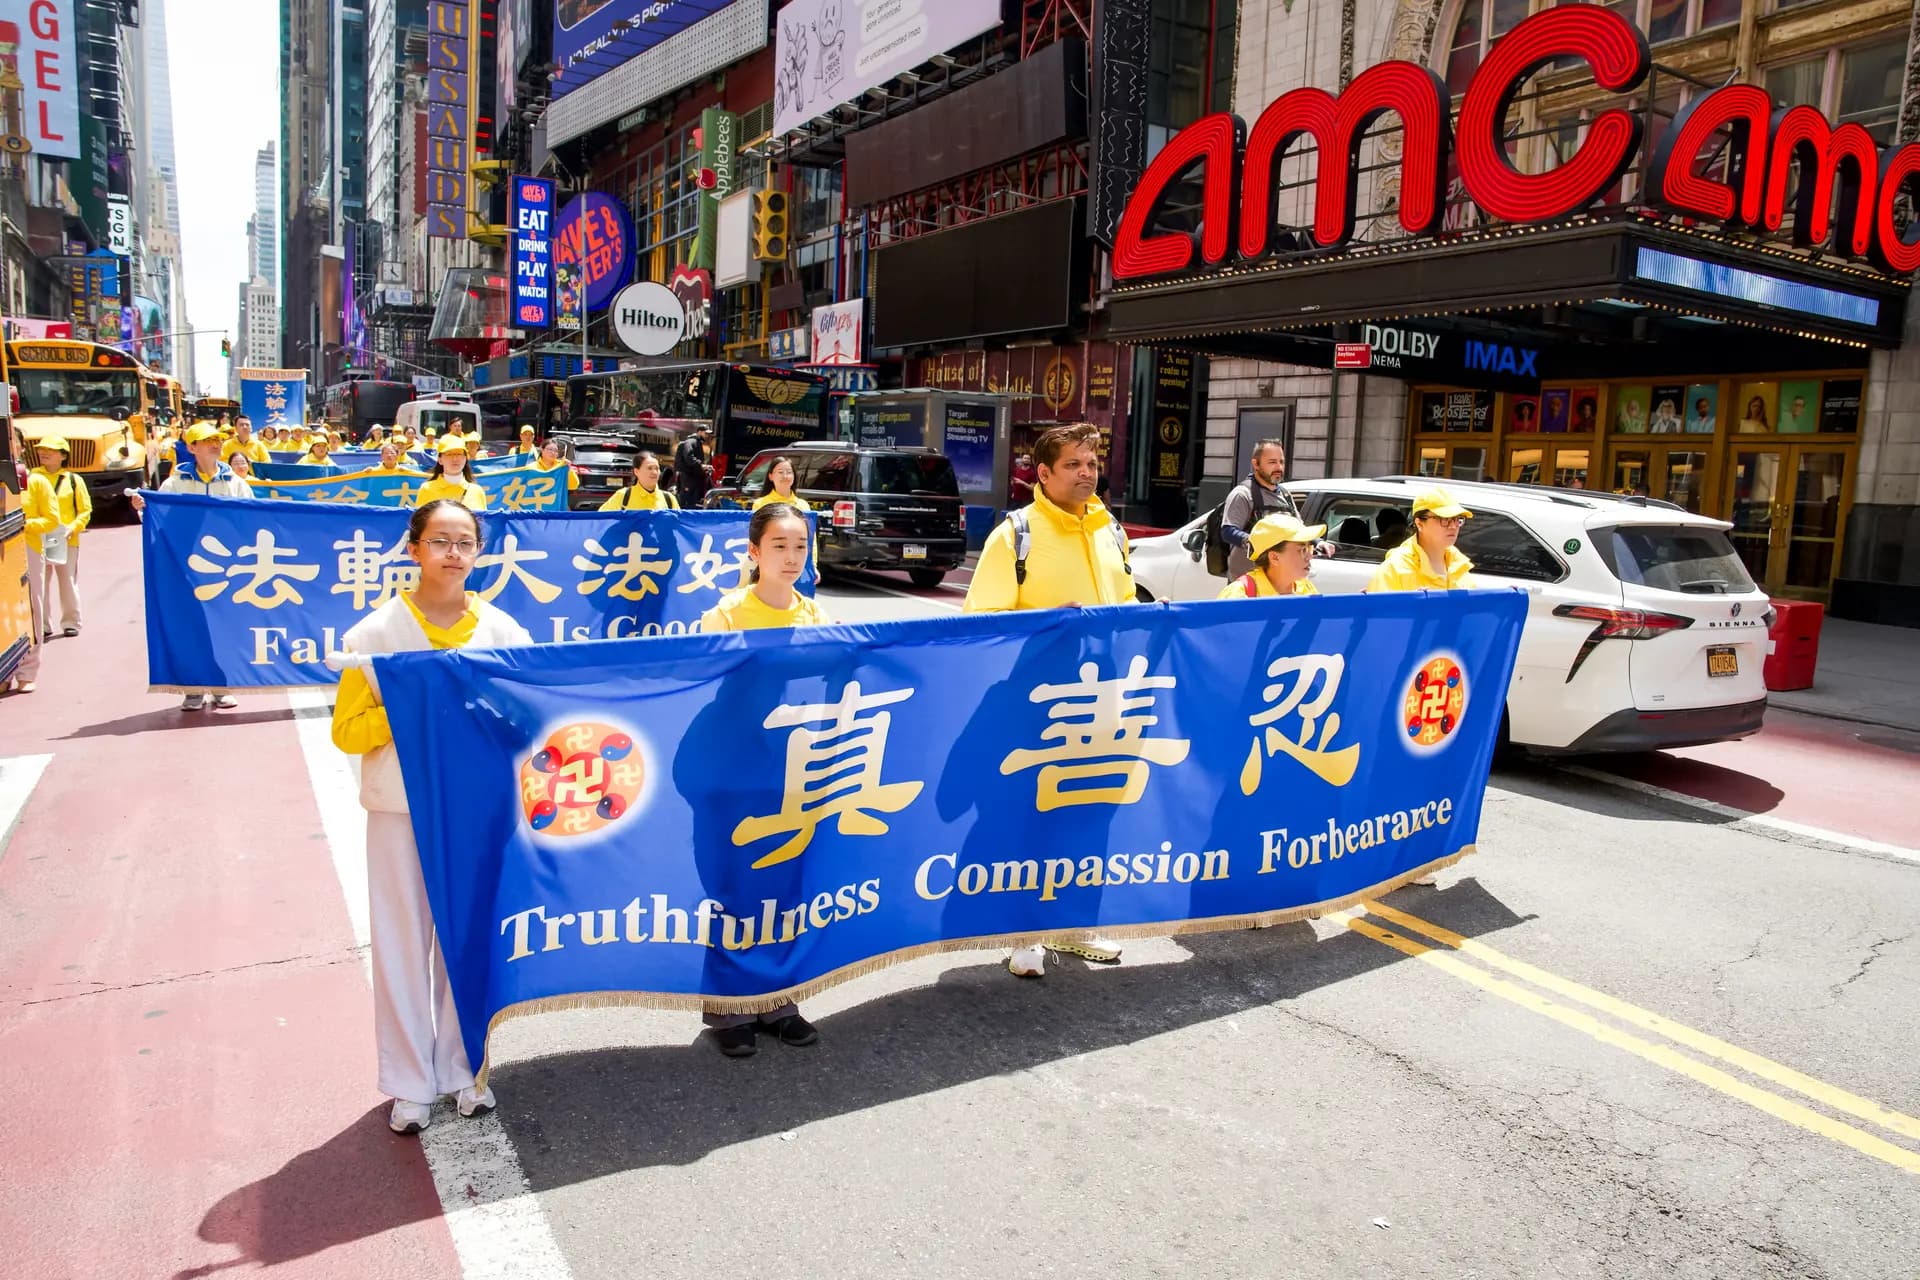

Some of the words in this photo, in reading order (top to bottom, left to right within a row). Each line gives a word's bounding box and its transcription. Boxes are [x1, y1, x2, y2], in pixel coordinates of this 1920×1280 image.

[709, 115, 731, 201] Applebee's
[519, 208, 548, 231] EAT
[600, 206, 620, 239] &
[530, 230, 536, 239] &
[518, 238, 548, 253] DRINK
[529, 253, 536, 262] &
[518, 261, 547, 278] PLAY
[529, 277, 536, 286] &
[518, 285, 547, 298] WATCH
[621, 308, 679, 330] Hilton
[1365, 324, 1440, 360] DOLBY
[21, 348, 63, 362] SCHOOL
[67, 348, 88, 362] BUS
[1371, 354, 1401, 369] INEMA
[1465, 339, 1539, 377] IMAX
[826, 367, 878, 391] GIFTS
[925, 357, 964, 386] House
[948, 409, 968, 419] Target
[946, 433, 978, 444] Streaming
[979, 435, 989, 443] TV
[947, 427, 966, 435] emails
[249, 627, 343, 664] Fal
[607, 615, 702, 638] Goo
[500, 877, 880, 963] Truthfulness
[914, 840, 1230, 902] Compassion
